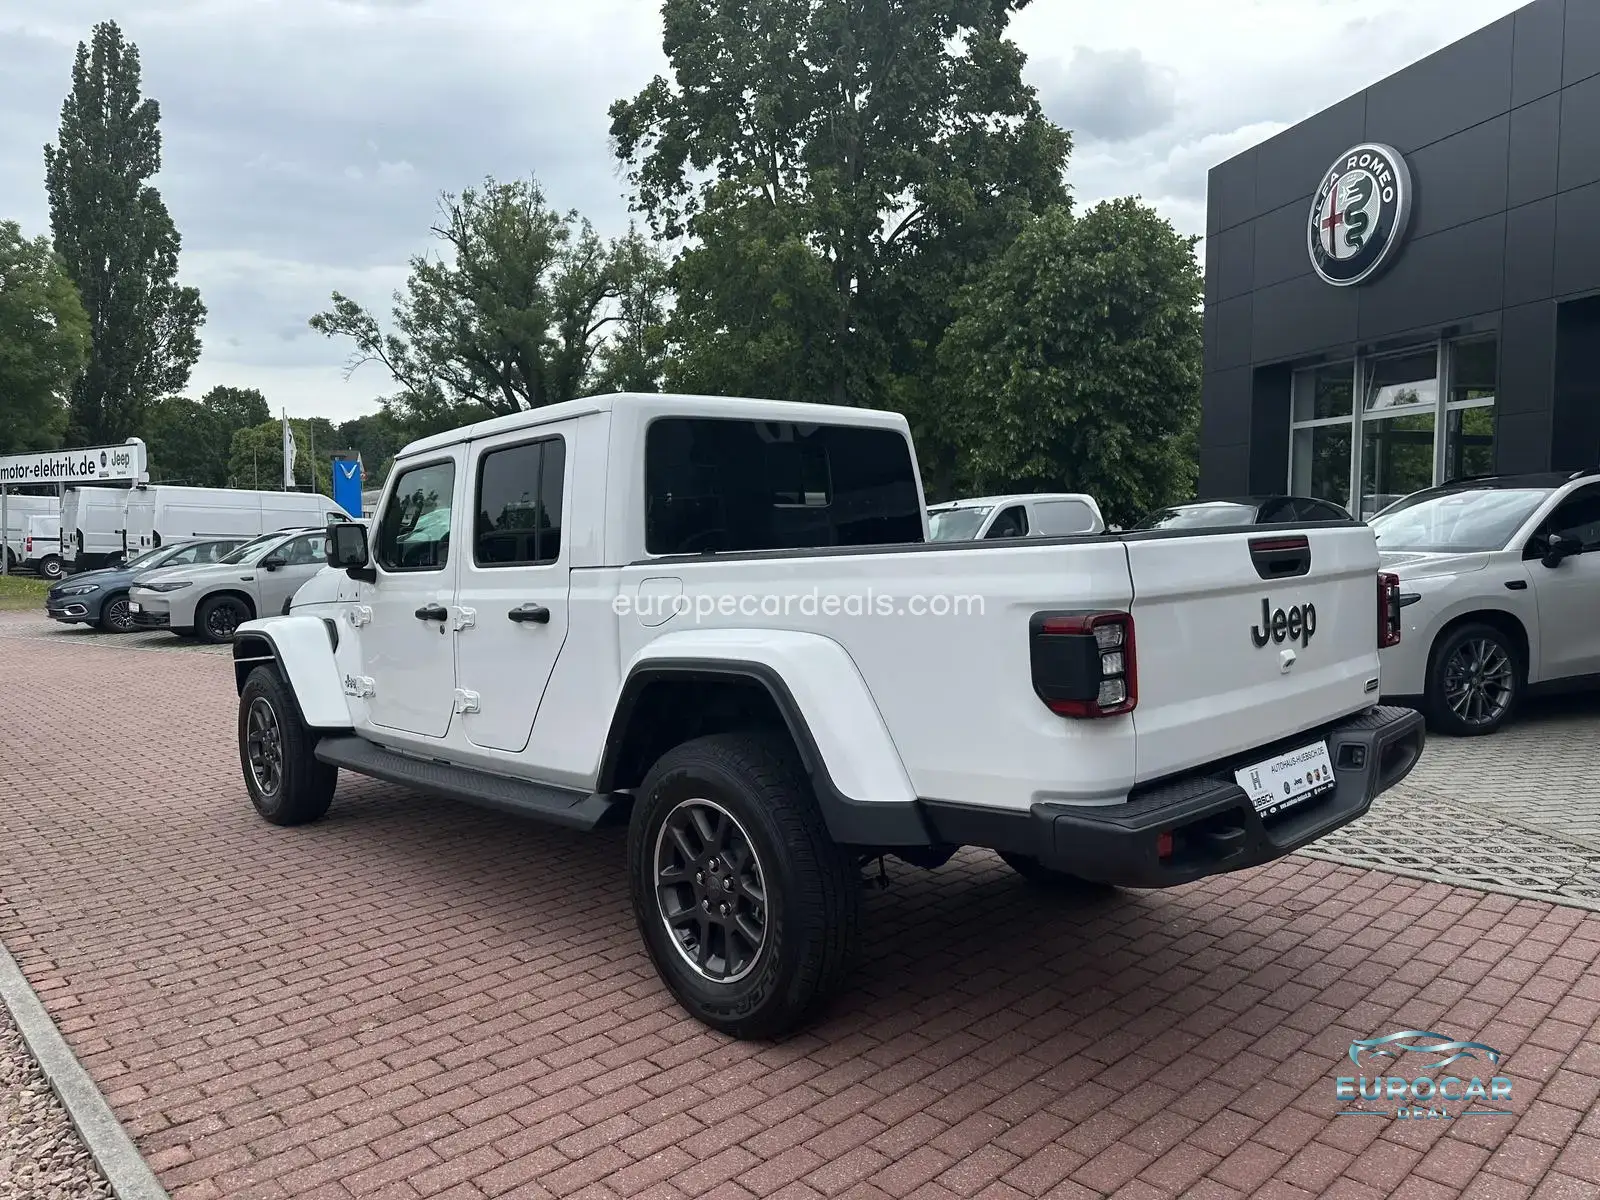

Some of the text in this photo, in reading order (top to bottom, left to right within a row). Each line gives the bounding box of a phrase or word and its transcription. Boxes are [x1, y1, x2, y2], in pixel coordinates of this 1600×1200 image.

[1312, 154, 1394, 228] ALFA ROMEO
[0, 455, 96, 480] motor-elektrik.de
[111, 450, 130, 468] Jeep
[1251, 597, 1316, 648] Jeep
